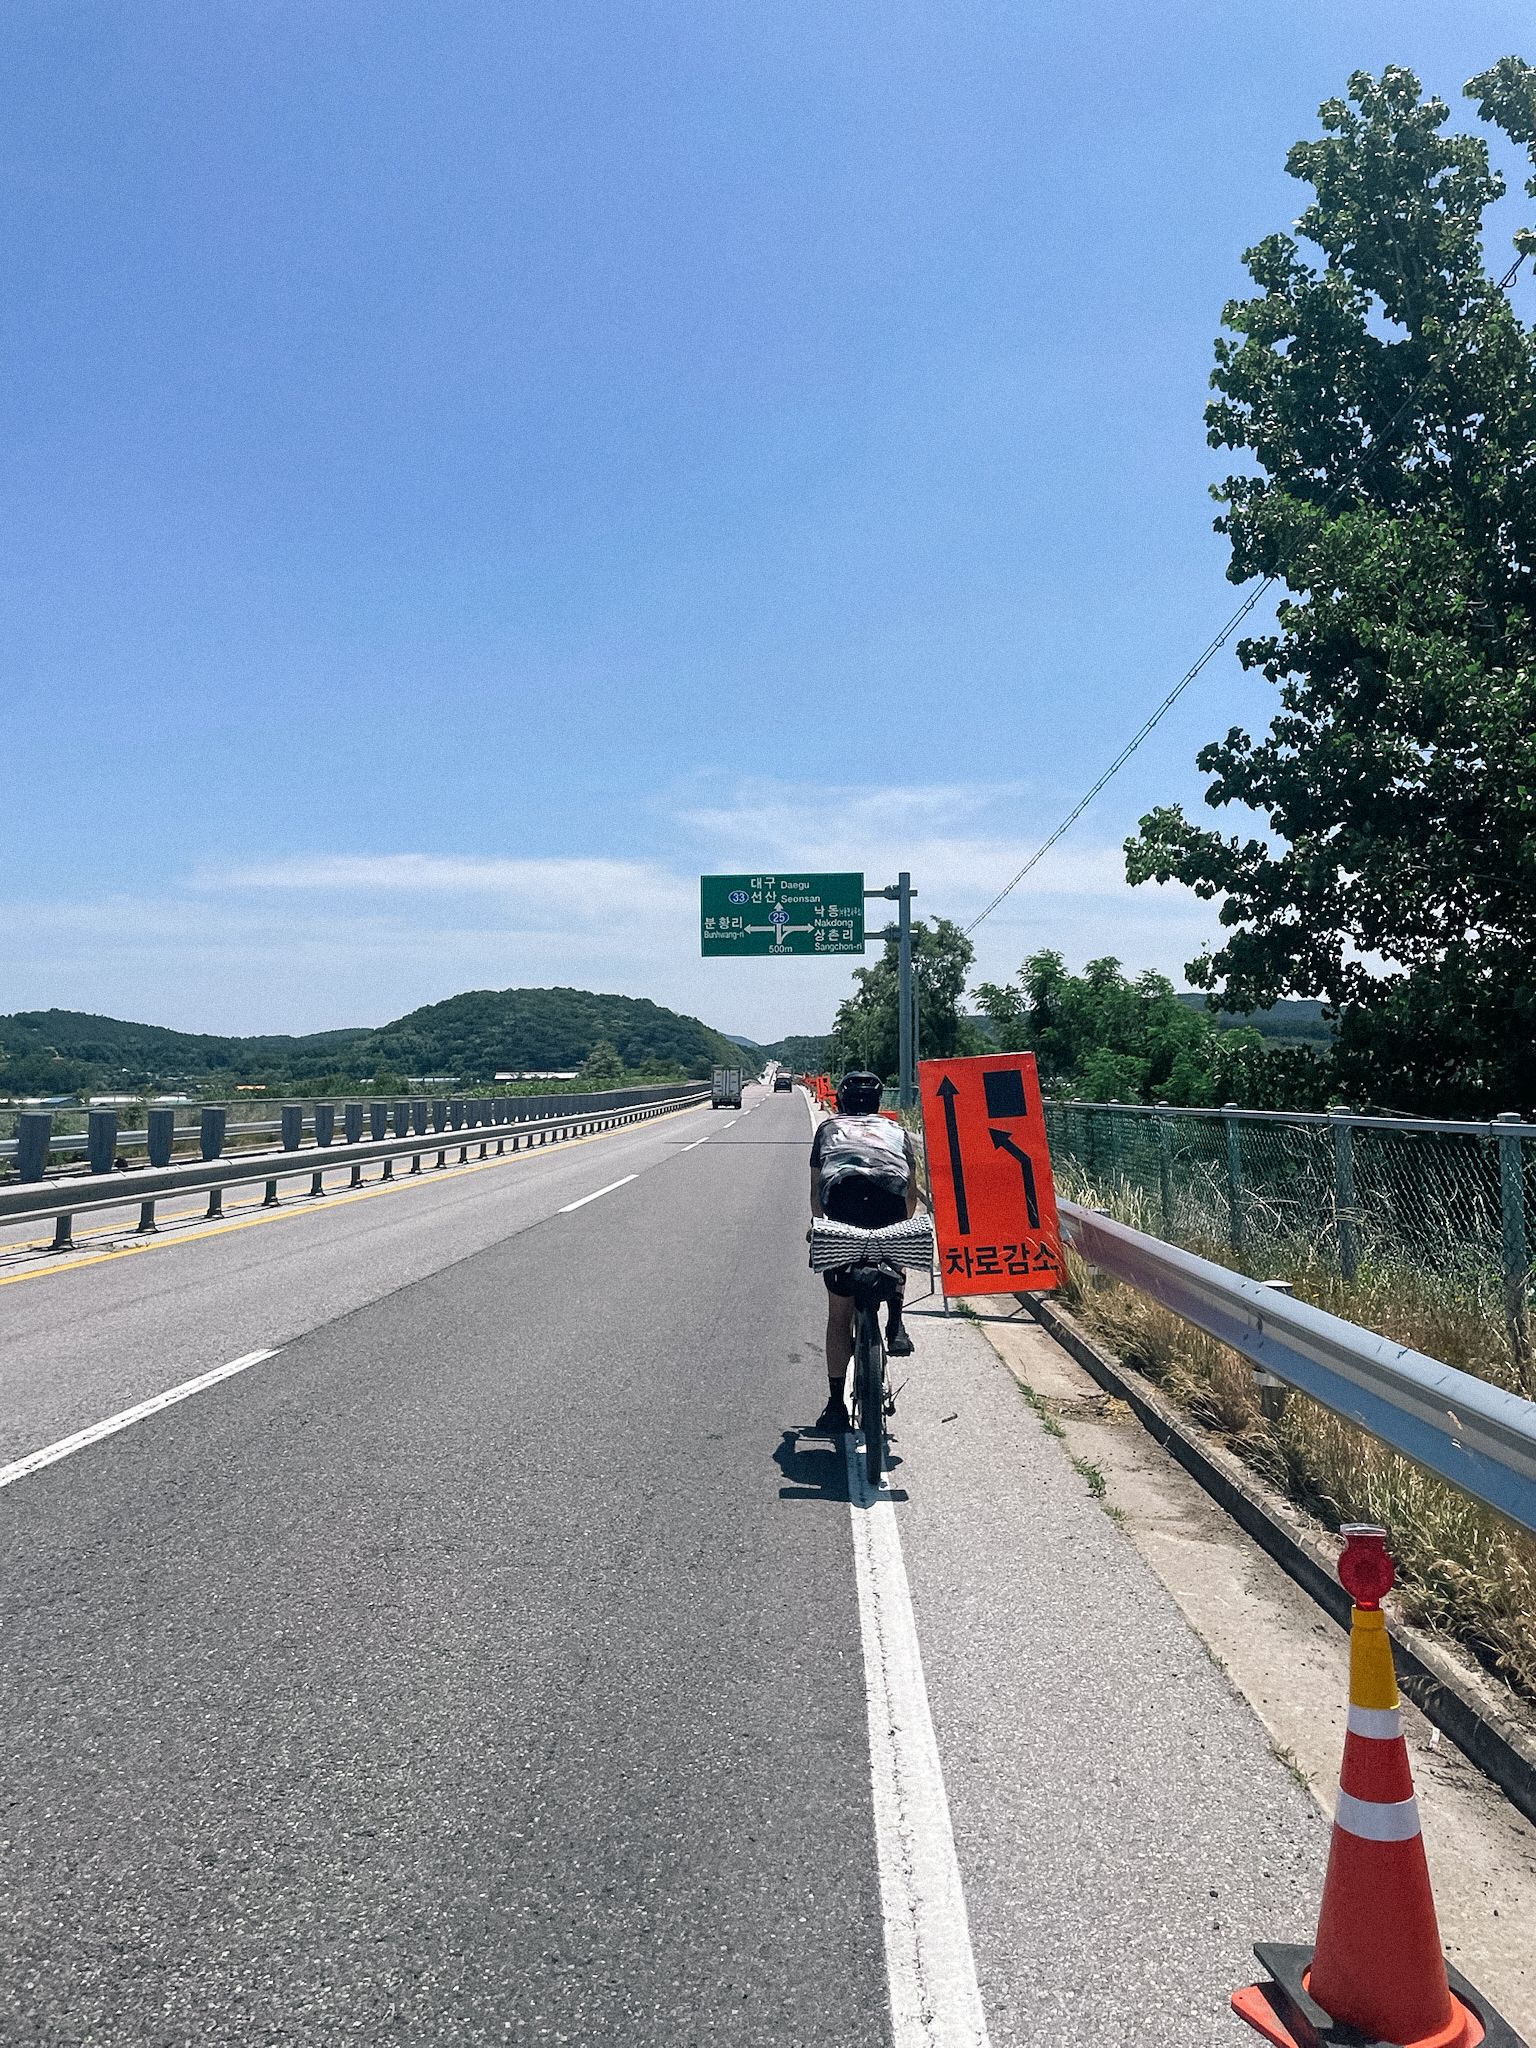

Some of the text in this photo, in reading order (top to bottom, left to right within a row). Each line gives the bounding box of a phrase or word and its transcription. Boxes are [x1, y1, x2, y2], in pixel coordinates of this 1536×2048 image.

[751, 876, 810, 891] 대구 Daegu
[733, 891, 821, 904] 33 선산 Seonsan
[814, 905, 839, 917] 낙동
[704, 916, 743, 930] 분황리
[773, 913, 785, 922] 25
[814, 919, 854, 928] Nakdong
[703, 930, 745, 940] Bunhwang-ri
[814, 929, 853, 942] 상촌리
[768, 944, 793, 953] 500m
[814, 942, 863, 953] Sangchon-ri
[945, 1242, 1058, 1278] 차로감소
